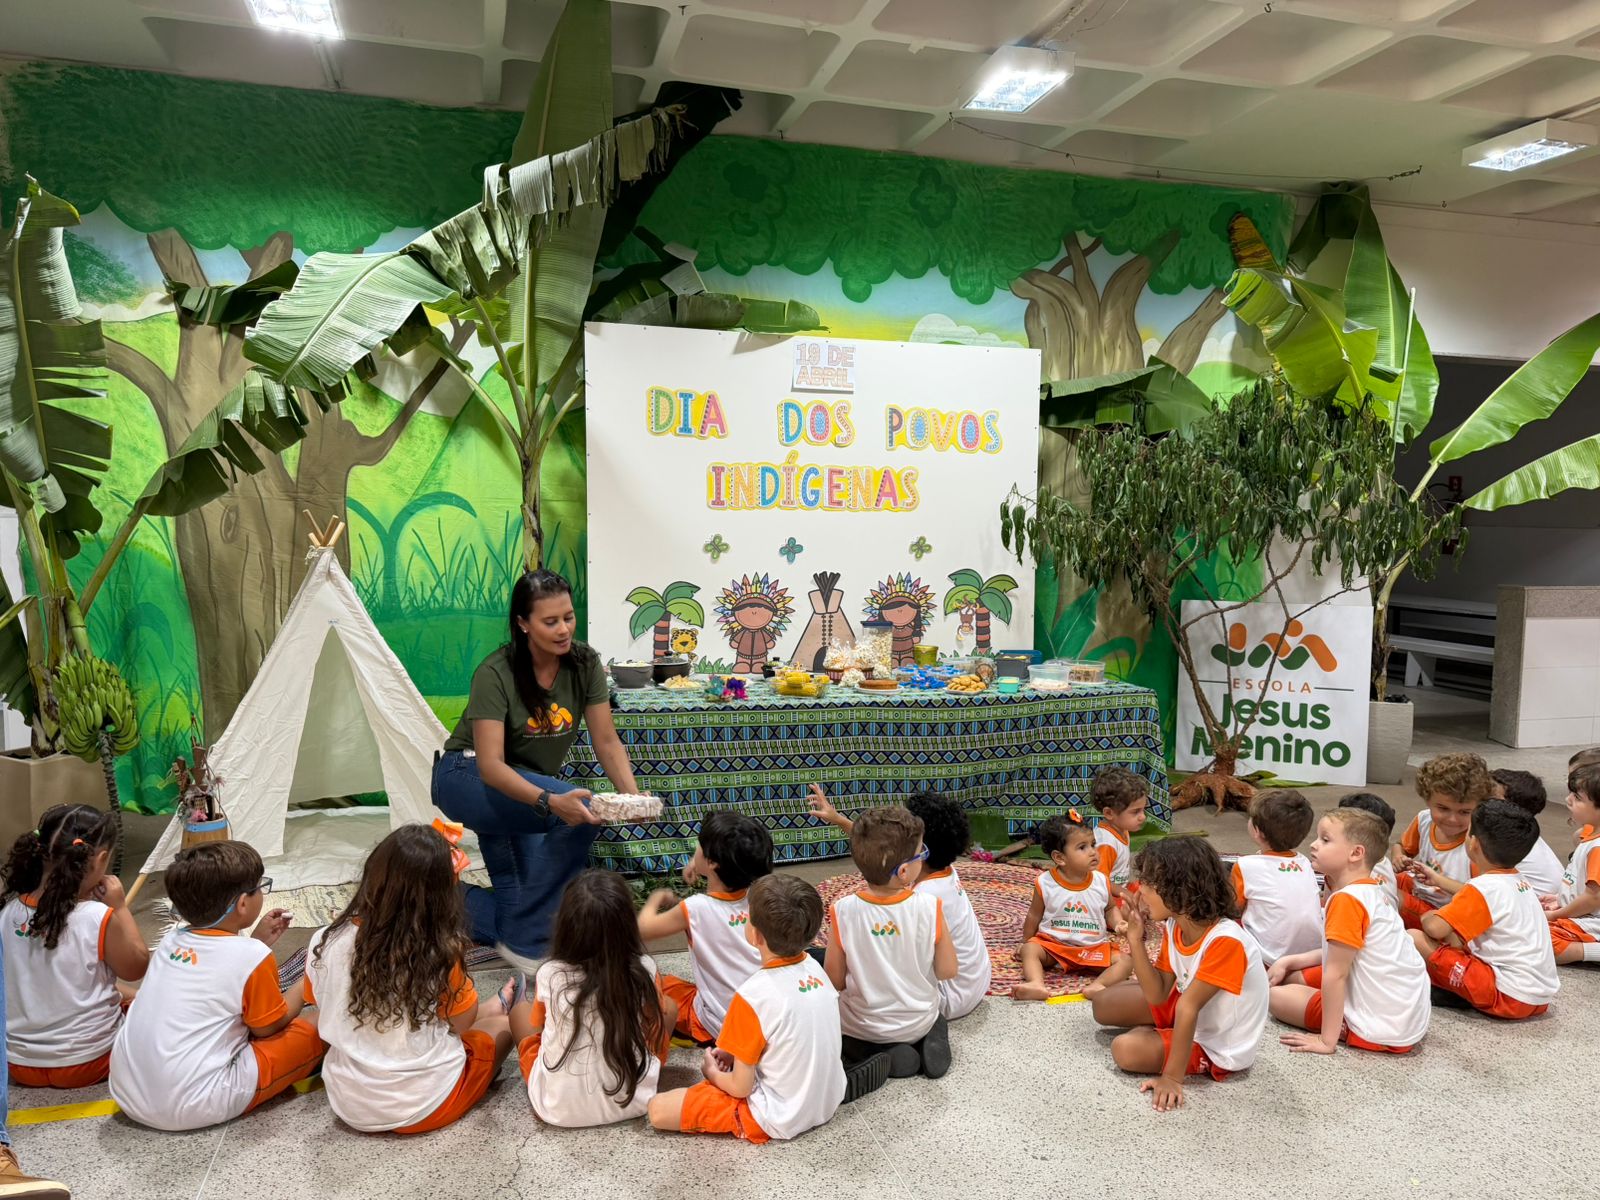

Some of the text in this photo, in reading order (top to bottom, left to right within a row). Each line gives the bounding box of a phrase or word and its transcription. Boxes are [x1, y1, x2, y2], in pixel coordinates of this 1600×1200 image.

[796, 343, 855, 367] 19 DE
[796, 366, 854, 388] ABRIL
[648, 387, 1002, 452] DIA DOS POVOS
[708, 451, 919, 510] INDÍGENAS
[1233, 678, 1312, 693] ESCOLA
[1219, 694, 1331, 730] Jesus
[1191, 727, 1351, 767] Menino
